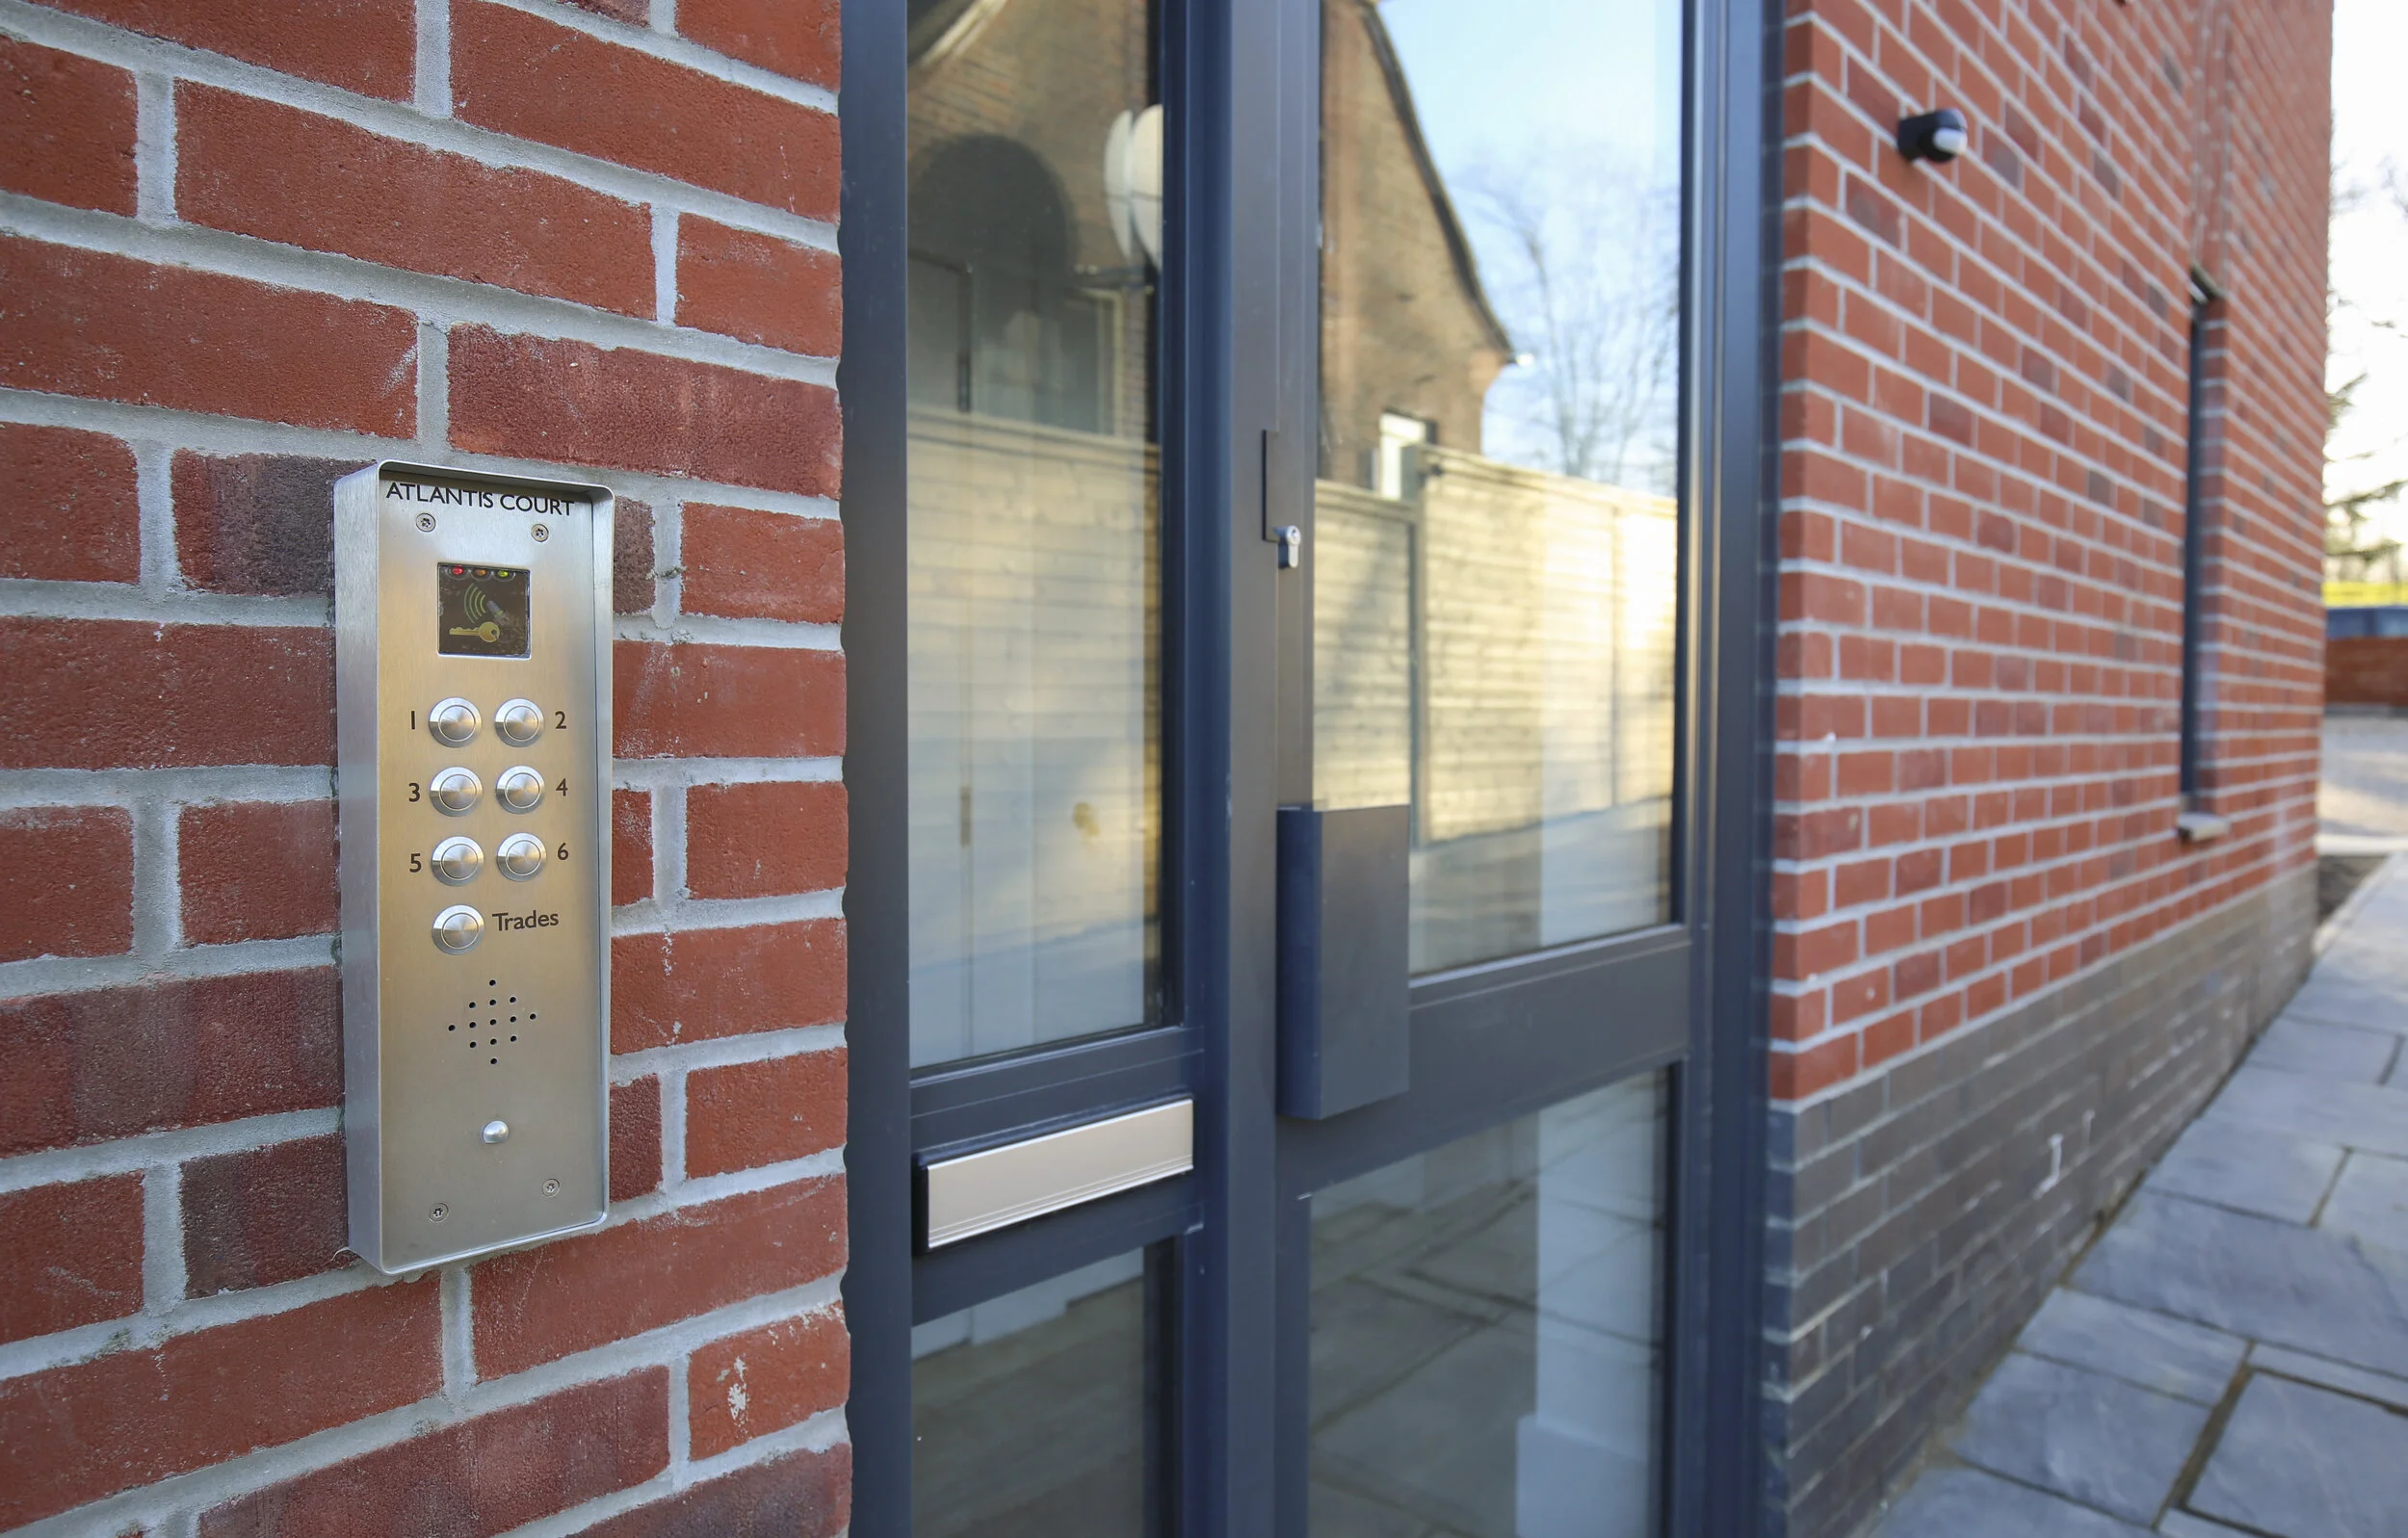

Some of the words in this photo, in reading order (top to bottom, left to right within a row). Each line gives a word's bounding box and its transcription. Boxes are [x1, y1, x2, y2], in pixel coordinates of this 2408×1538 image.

[386, 482, 493, 508] ATLANTIS
[500, 493, 575, 516] COURT
[410, 710, 416, 730] 1
[555, 711, 567, 730] 2
[408, 782, 421, 802] 3
[556, 778, 568, 796] 4
[557, 842, 569, 860] 6
[409, 853, 422, 873] 5
[492, 910, 559, 931] Trades
